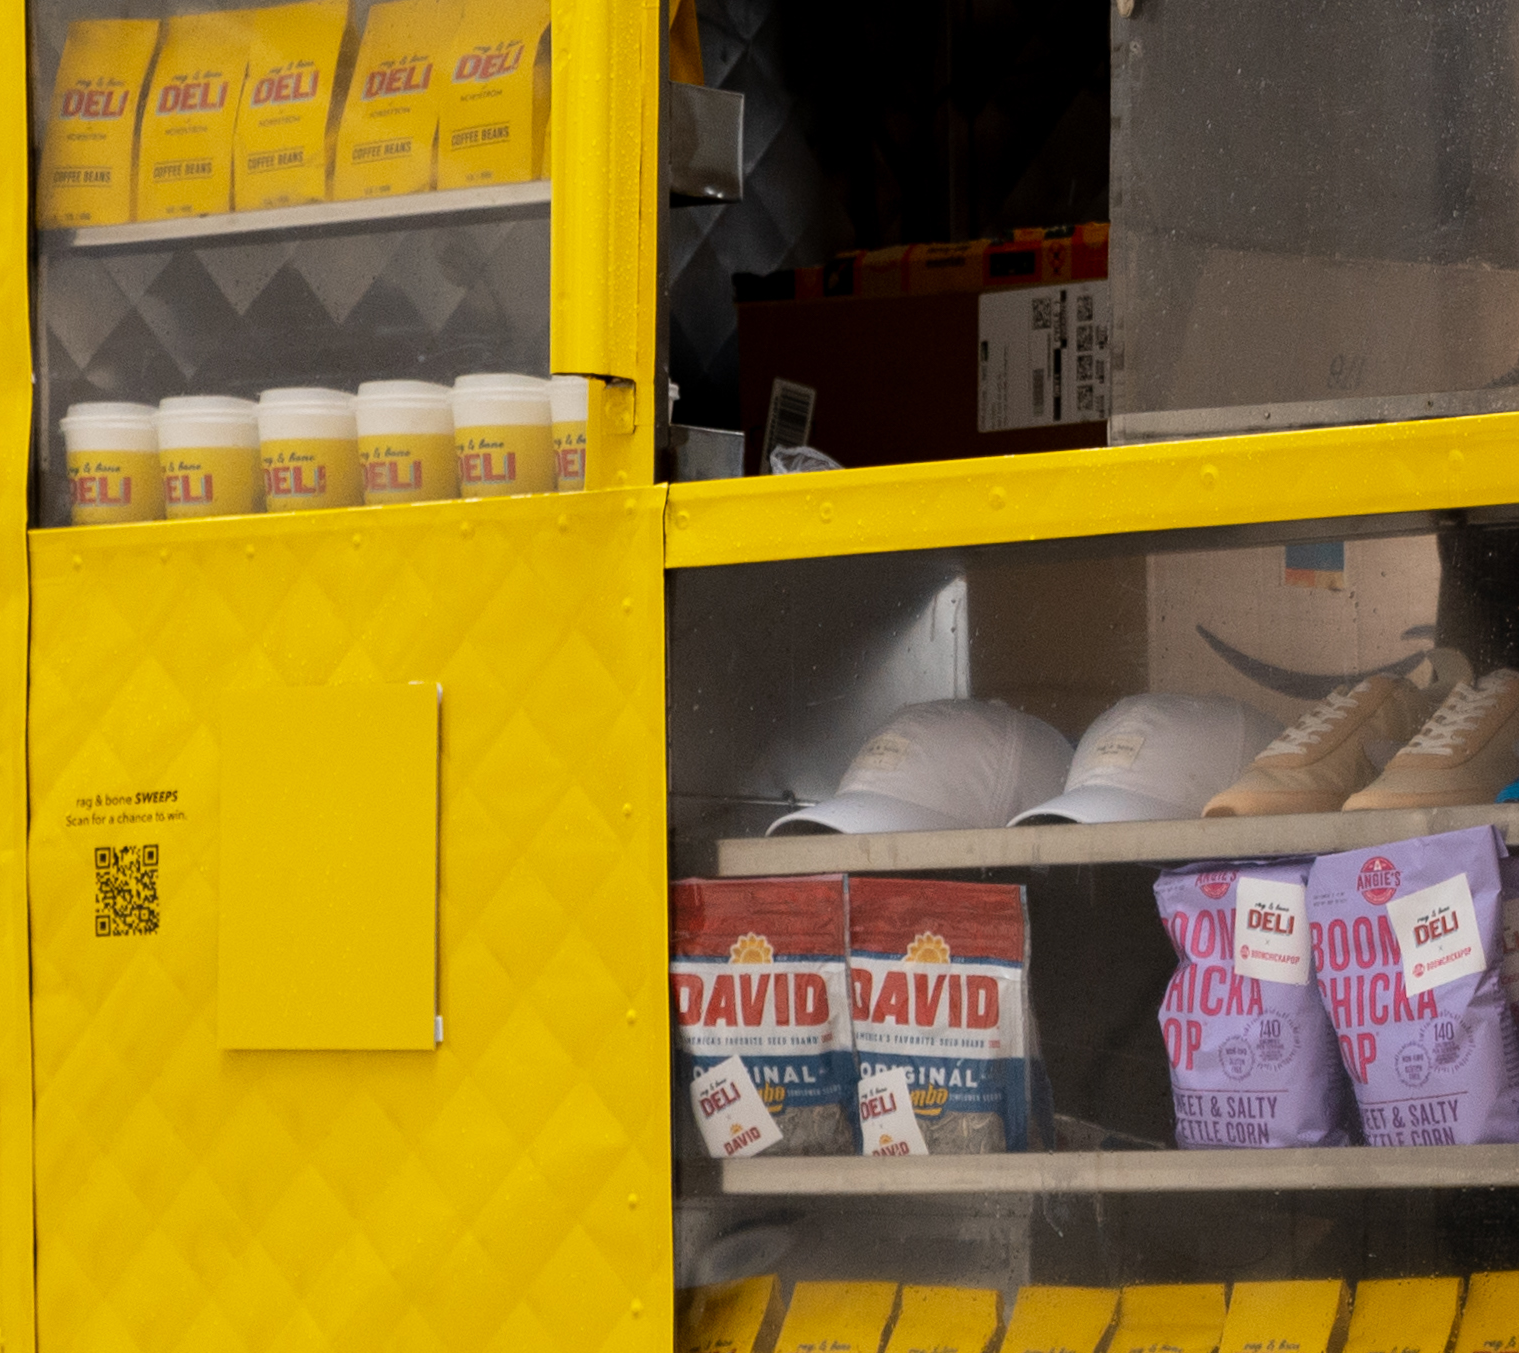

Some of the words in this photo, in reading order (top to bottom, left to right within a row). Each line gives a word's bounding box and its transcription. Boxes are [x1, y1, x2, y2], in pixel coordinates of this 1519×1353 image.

[452, 45, 525, 83] DELI
[250, 70, 319, 108] DELI
[361, 64, 433, 102] DELI
[60, 89, 130, 120] DELI
[156, 81, 229, 116] DELI
[76, 798, 92, 810] rag
[95, 795, 102, 807] &
[105, 794, 132, 806] bone
[134, 790, 178, 805] SWEEPS
[66, 815, 90, 827] Scan
[92, 813, 106, 825] for
[108, 816, 114, 824] a
[117, 812, 153, 825] chance
[155, 812, 165, 822] to
[1356, 871, 1401, 891] ANGIE'S
[1247, 909, 1295, 937] DELI
[1413, 910, 1459, 948] DELI
[669, 972, 829, 1027] DAVID
[850, 968, 999, 1029] DAVID
[1259, 1019, 1281, 1038] 140
[1434, 1021, 1454, 1041] 140
[700, 1081, 741, 1119] DELI
[860, 1093, 897, 1121] DELI
[1211, 1095, 1222, 1118] &
[1227, 1096, 1277, 1119] SALTY
[1392, 1107, 1406, 1128] &
[1408, 1100, 1458, 1123] SALTY
[724, 1126, 762, 1156] DAVID
[1226, 1122, 1269, 1144] CORN
